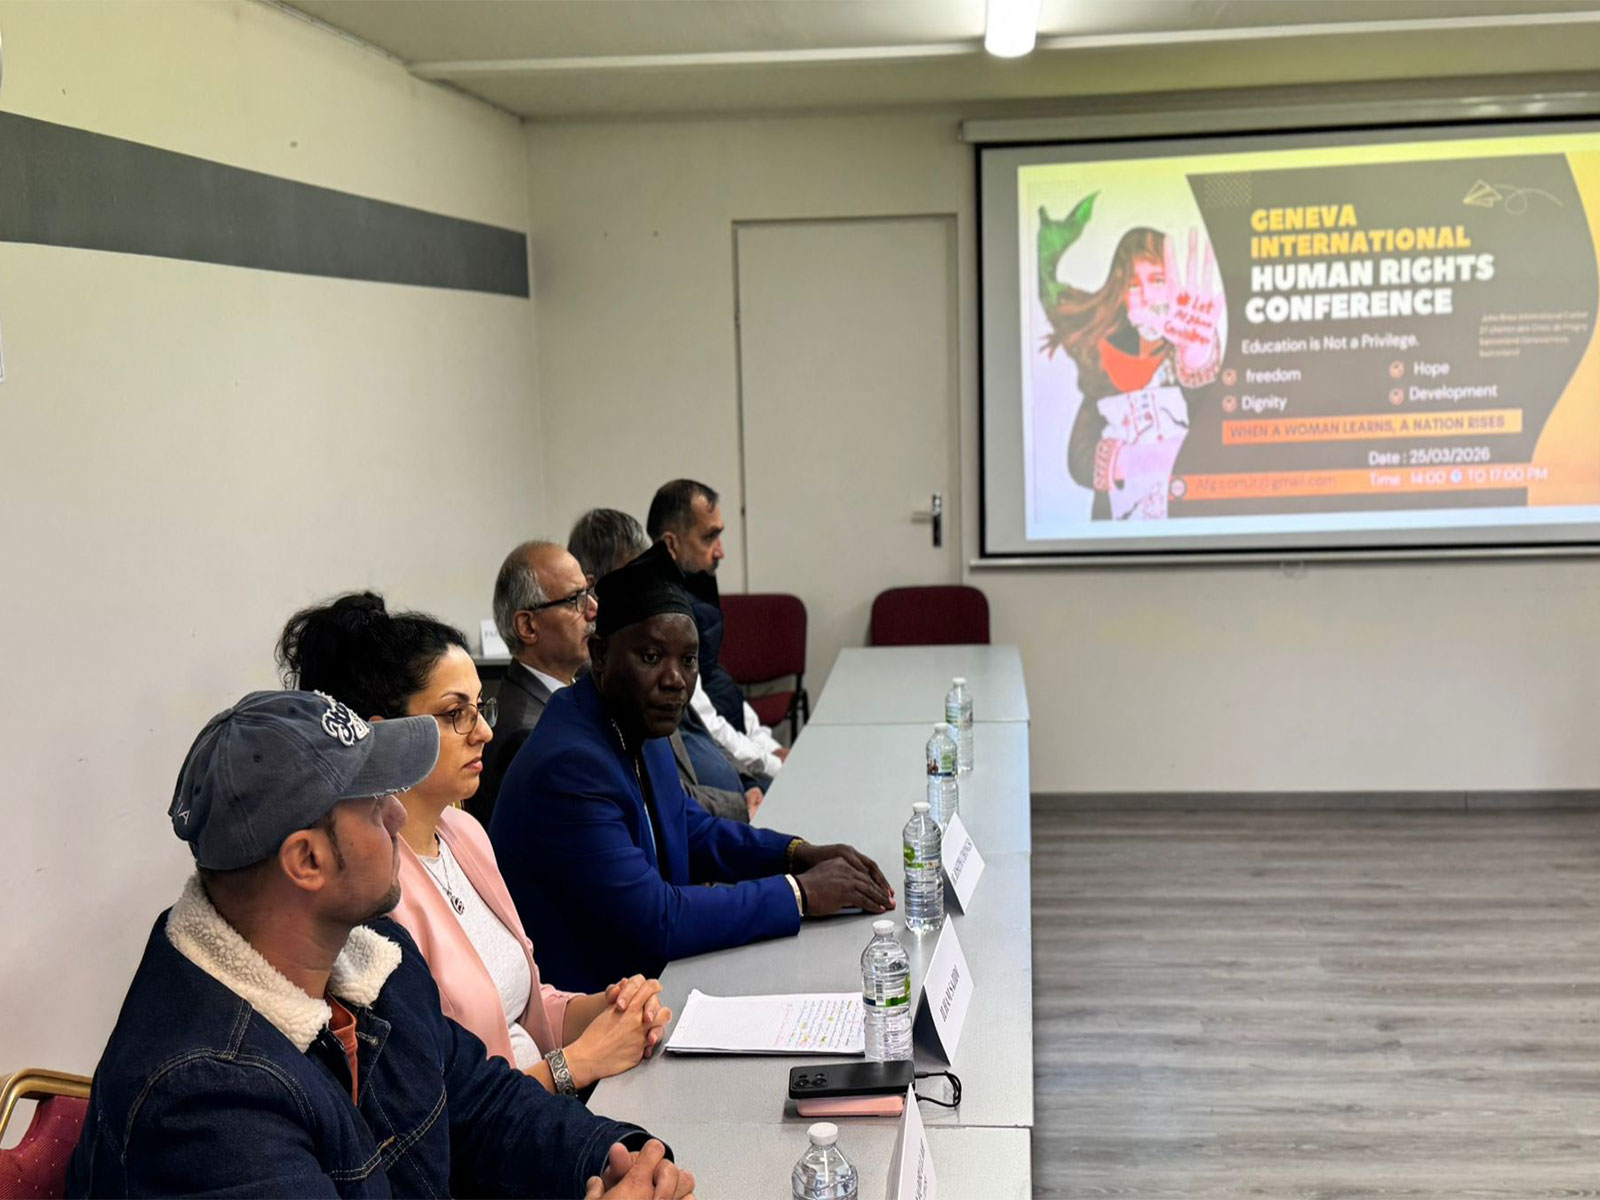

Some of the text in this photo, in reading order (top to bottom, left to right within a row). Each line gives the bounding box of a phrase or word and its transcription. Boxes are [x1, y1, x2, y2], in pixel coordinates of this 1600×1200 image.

[1251, 204, 1357, 232] GENEVA
[1251, 225, 1471, 259] INTERNATIONAL
[1251, 253, 1495, 292] HUMAN RIGHTS
[1245, 288, 1453, 323] CONFERENCE
[1241, 333, 1419, 354] Education is Not a Privilege.
[1246, 368, 1301, 383] freedom
[1413, 361, 1449, 378] Hope
[1241, 395, 1287, 412] Dignity
[1409, 384, 1497, 403] Development
[1230, 425, 1268, 439] WHEN
[1272, 425, 1282, 437] A
[1285, 422, 1339, 436] WOMAN
[1401, 419, 1410, 431] A
[1413, 417, 1464, 431] NATION
[1467, 415, 1505, 429] RISES
[1368, 450, 1400, 466] Date
[1409, 446, 1491, 465] 25/03/2026
[1370, 471, 1400, 487] Time
[1468, 468, 1487, 482] TO
[1527, 466, 1549, 481] PM
